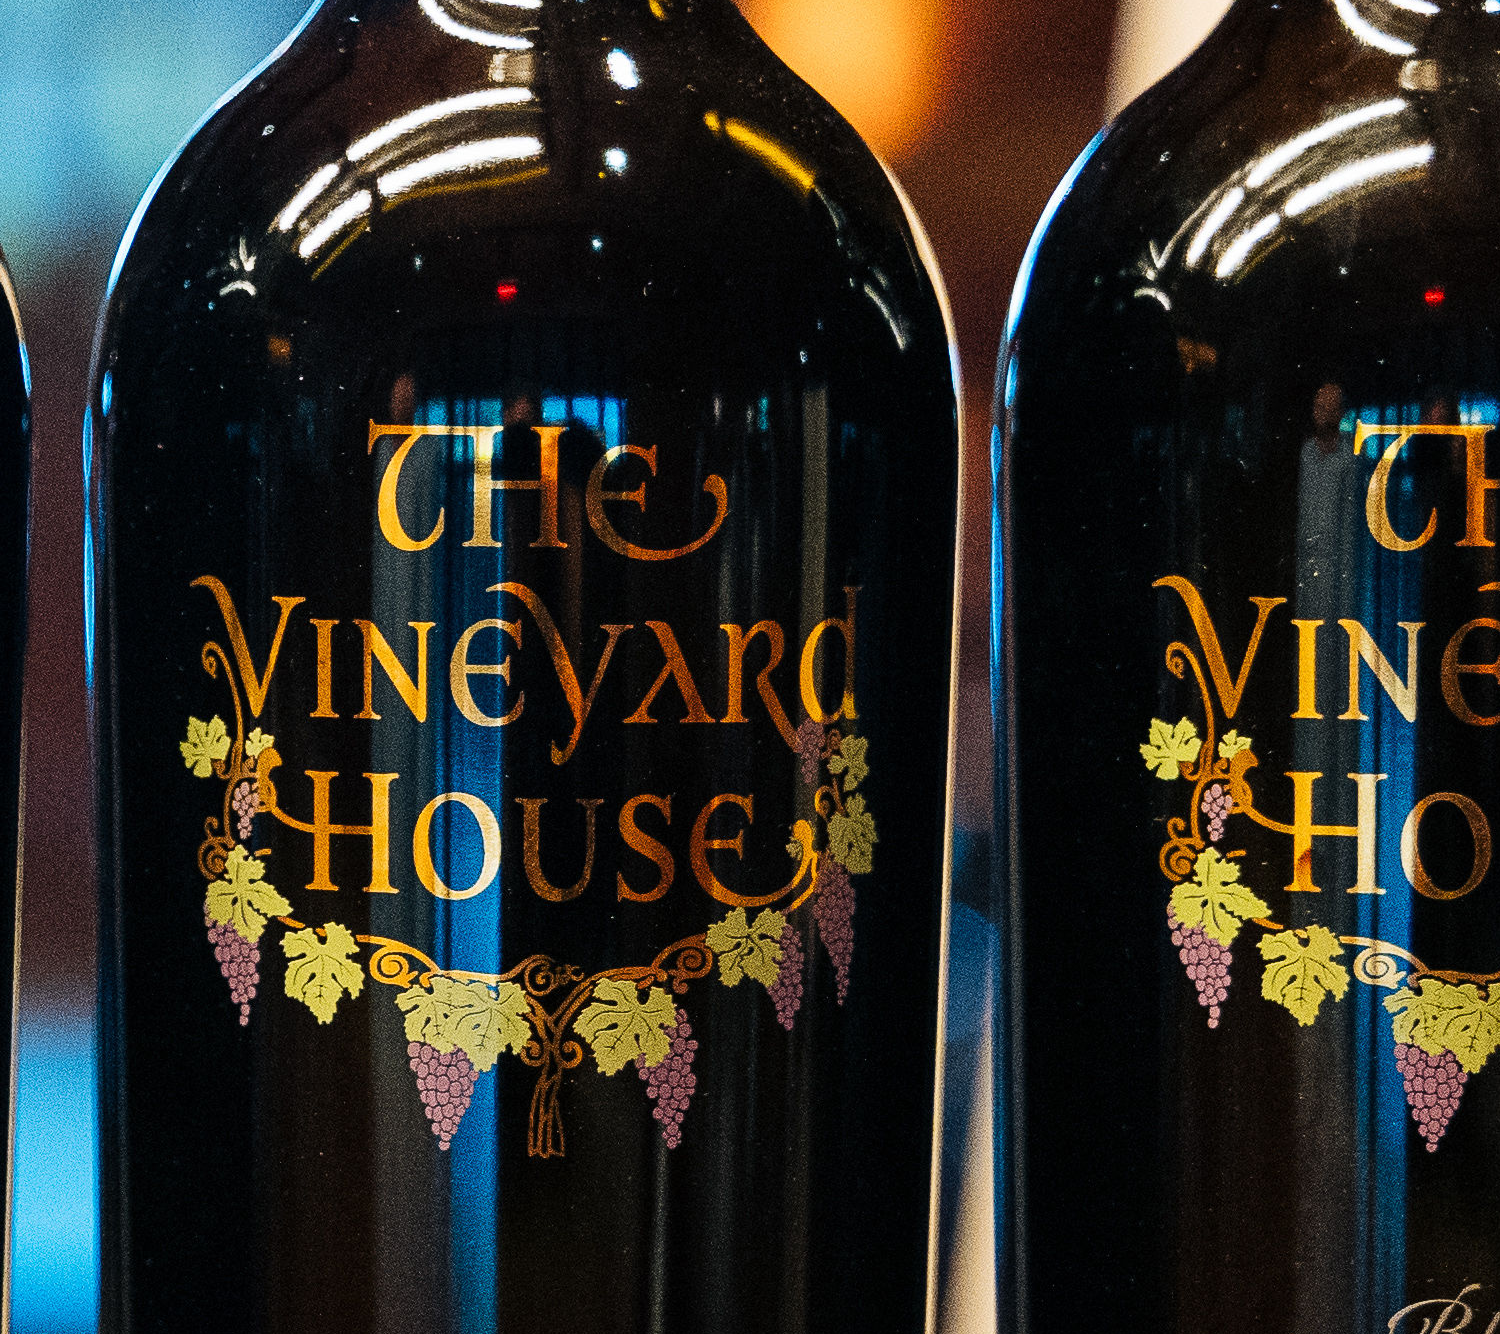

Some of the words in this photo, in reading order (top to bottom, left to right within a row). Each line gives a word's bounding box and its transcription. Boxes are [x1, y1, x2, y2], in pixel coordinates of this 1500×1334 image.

[367, 418, 729, 561] THE
[190, 573, 864, 766] VINEYARD
[255, 747, 815, 908] HOUSE
